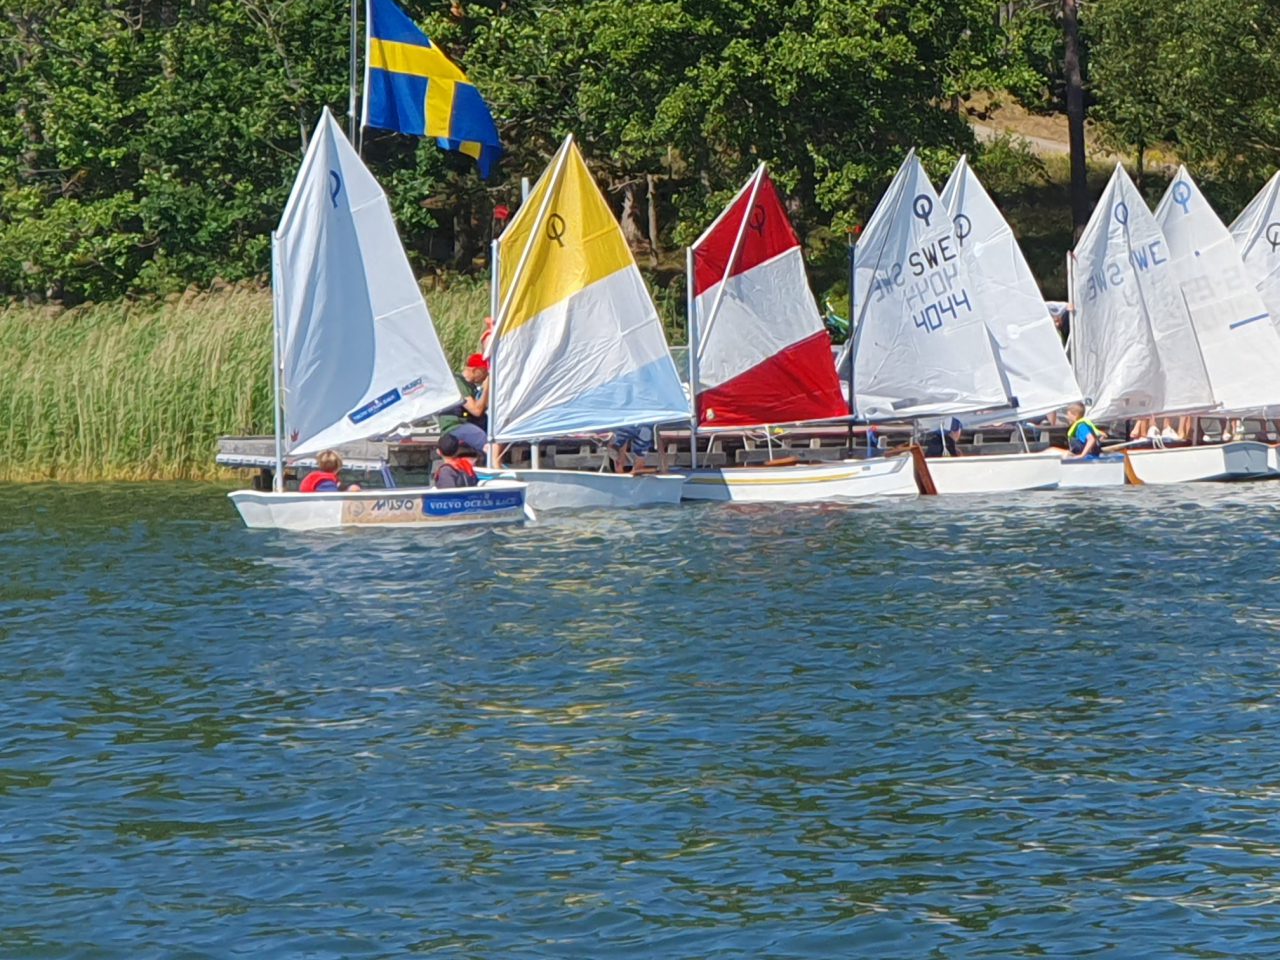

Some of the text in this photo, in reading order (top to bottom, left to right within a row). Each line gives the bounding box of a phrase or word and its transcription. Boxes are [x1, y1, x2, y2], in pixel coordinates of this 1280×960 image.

[909, 236, 957, 276] SWE
[913, 289, 972, 334] 4044
[429, 501, 461, 511] VOLVO
[464, 499, 493, 509] OCEAN
